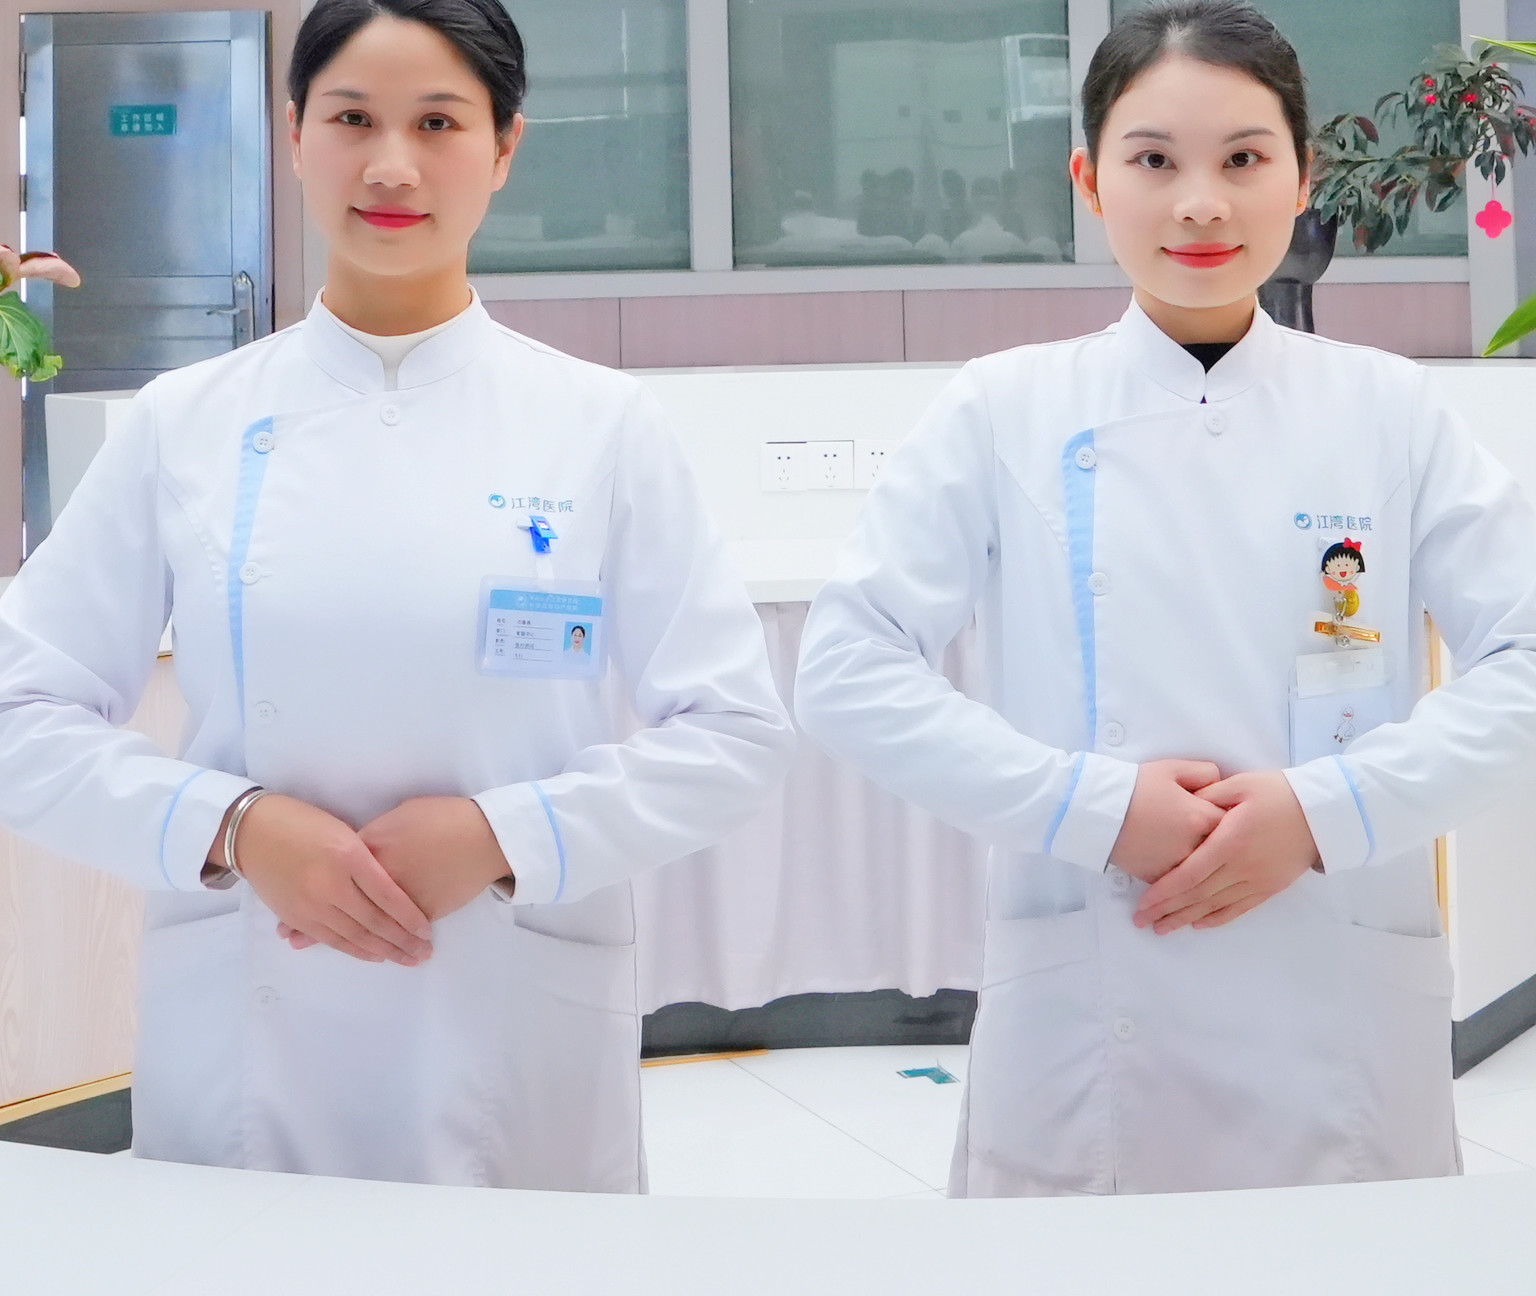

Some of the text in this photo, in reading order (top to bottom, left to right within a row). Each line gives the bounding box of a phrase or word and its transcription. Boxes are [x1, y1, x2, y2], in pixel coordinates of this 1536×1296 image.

[511, 497, 574, 513] 江湾医院
[1316, 515, 1373, 532] 江湾医院
